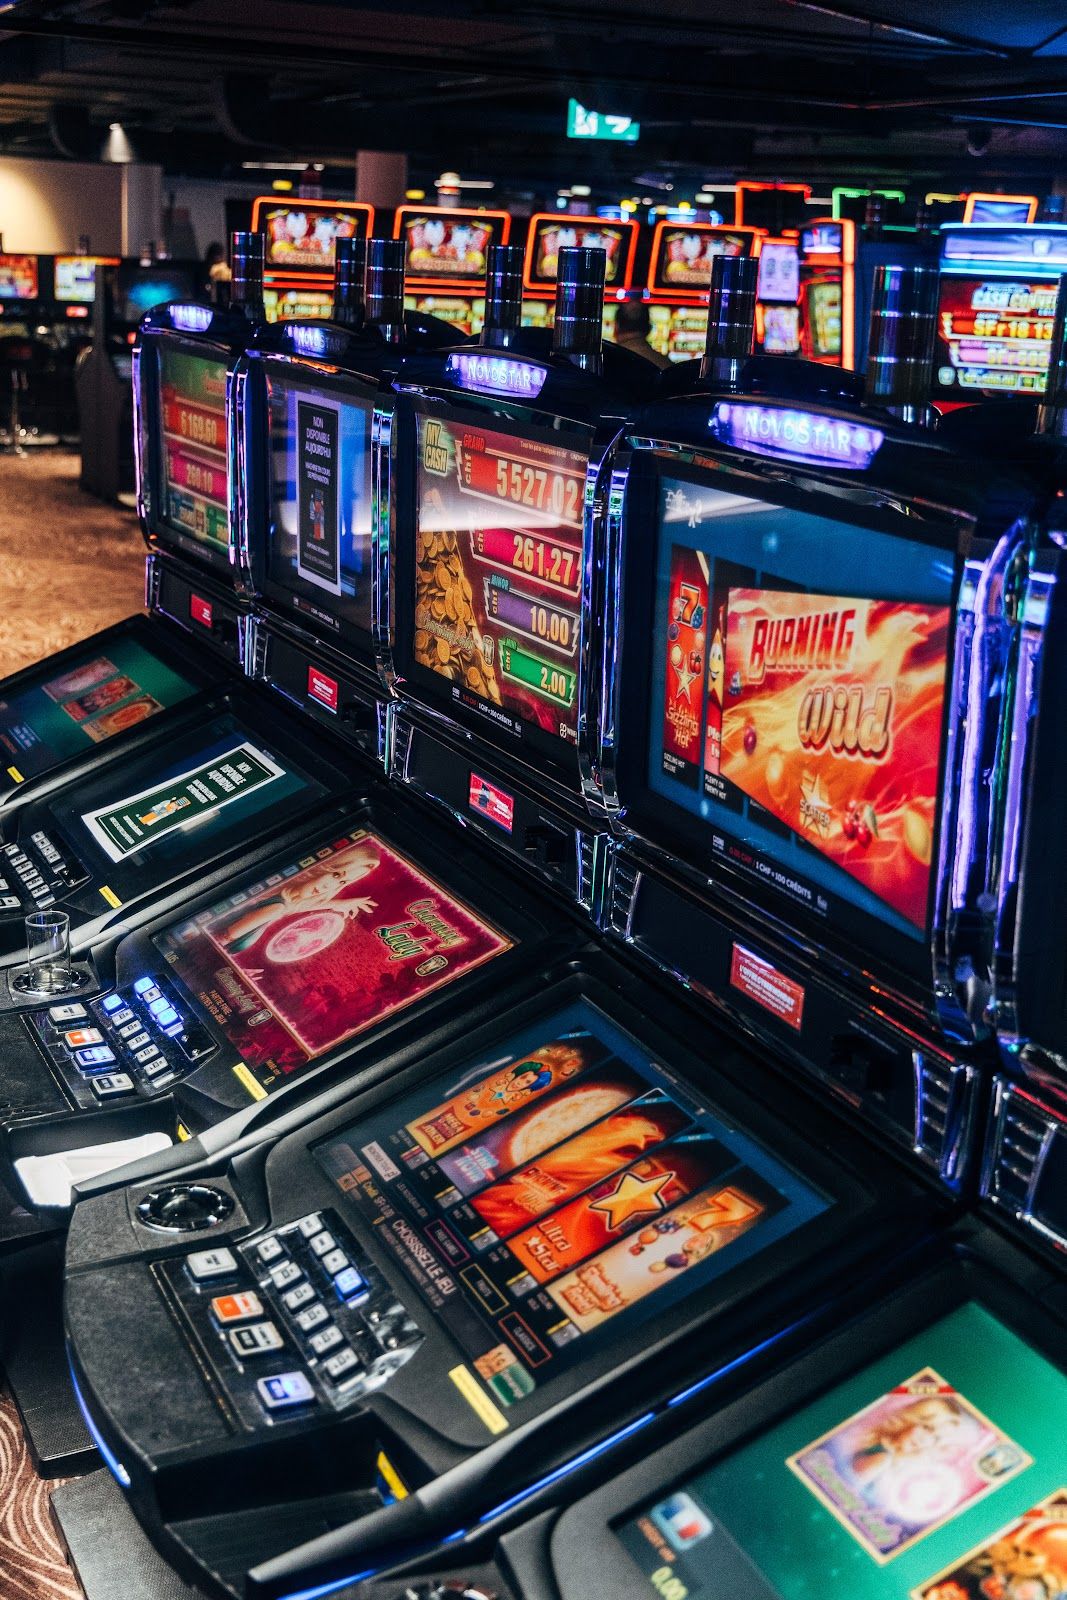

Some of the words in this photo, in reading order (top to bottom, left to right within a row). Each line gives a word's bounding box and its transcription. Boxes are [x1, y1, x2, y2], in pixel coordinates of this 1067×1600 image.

[467, 361, 531, 390] NOVOSTAR
[427, 421, 441, 446] MY
[463, 433, 485, 450] GRAND
[744, 410, 850, 452] NOVOSTAR
[425, 448, 447, 473] CASH
[464, 453, 472, 485] chf
[513, 534, 573, 587] 261,27
[530, 605, 569, 646] 10,00
[748, 609, 856, 684] BURNING
[540, 667, 566, 697] 2,00
[799, 684, 893, 760] Wild
[407, 896, 469, 951] Charming
[374, 919, 434, 964] Lady
[422, 1123, 444, 1145] JOKER
[445, 1113, 462, 1132] MEGA
[391, 1218, 433, 1268] CHOISISSEZ
[537, 1217, 572, 1251] Ultra
[426, 1261, 443, 1280] LE
[533, 1243, 561, 1273] Star
[434, 1273, 457, 1296] JEU
